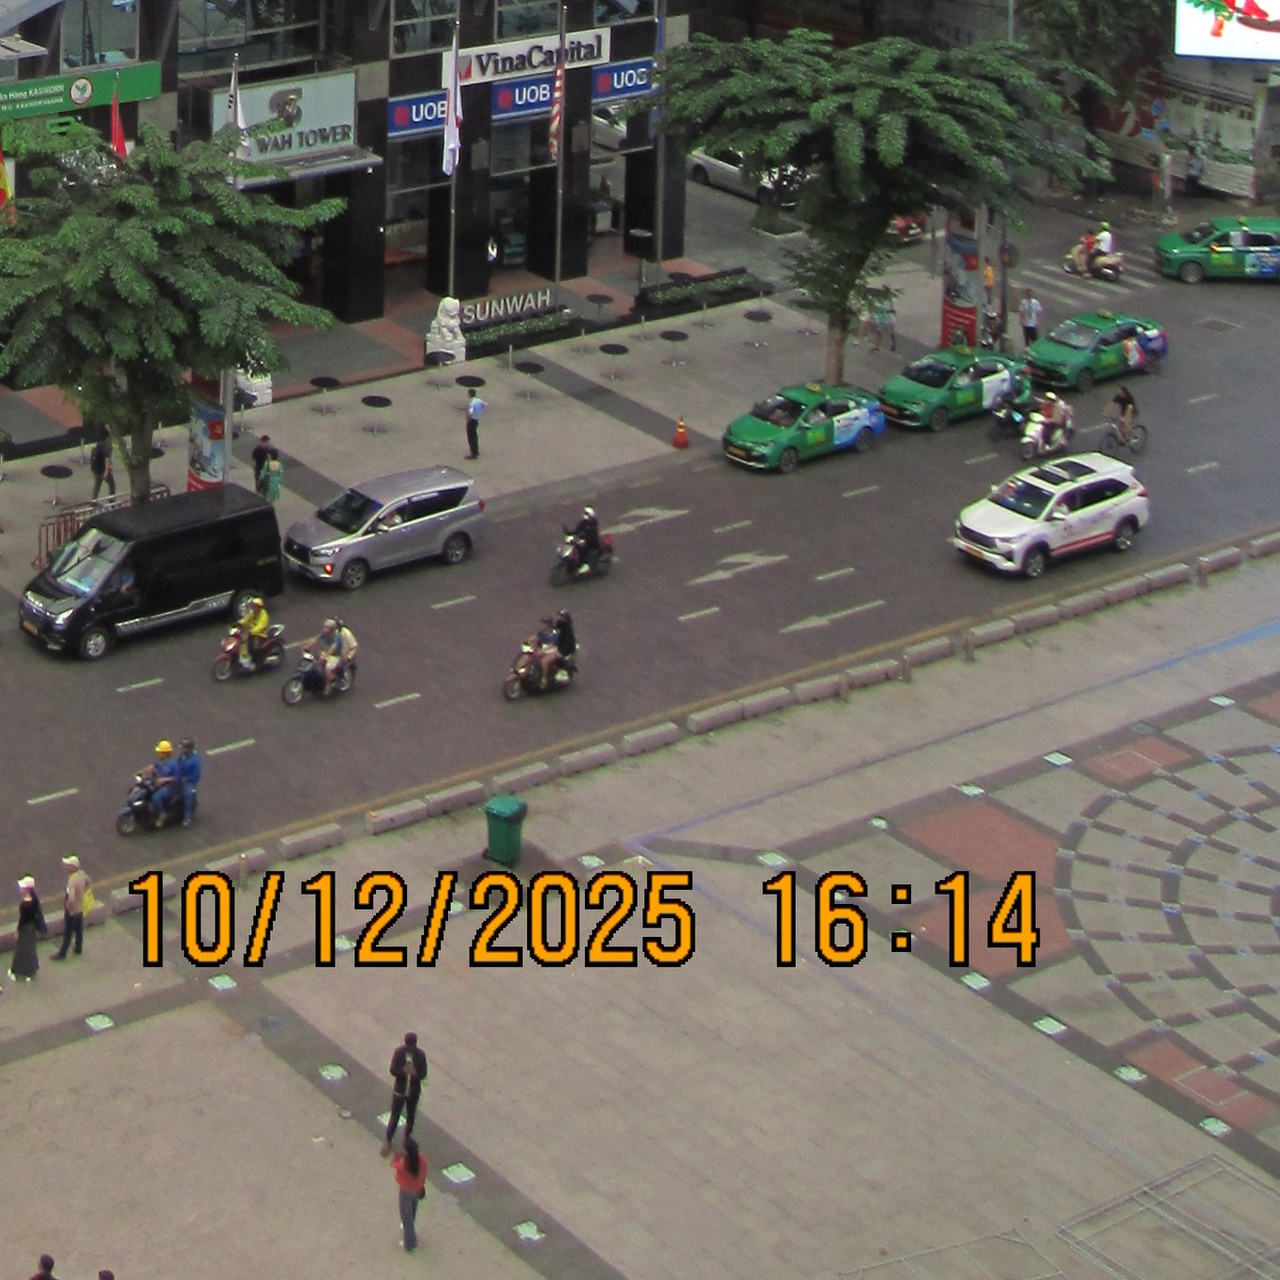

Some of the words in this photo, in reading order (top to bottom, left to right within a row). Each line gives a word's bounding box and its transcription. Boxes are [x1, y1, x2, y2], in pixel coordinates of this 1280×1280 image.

[475, 34, 603, 77] VinaCapital
[614, 68, 648, 90] UOB
[515, 84, 551, 106] UOB
[411, 100, 448, 123] UOB
[255, 133, 293, 154] WAH
[298, 124, 352, 148] TOWER
[462, 288, 551, 325] SUNWAH
